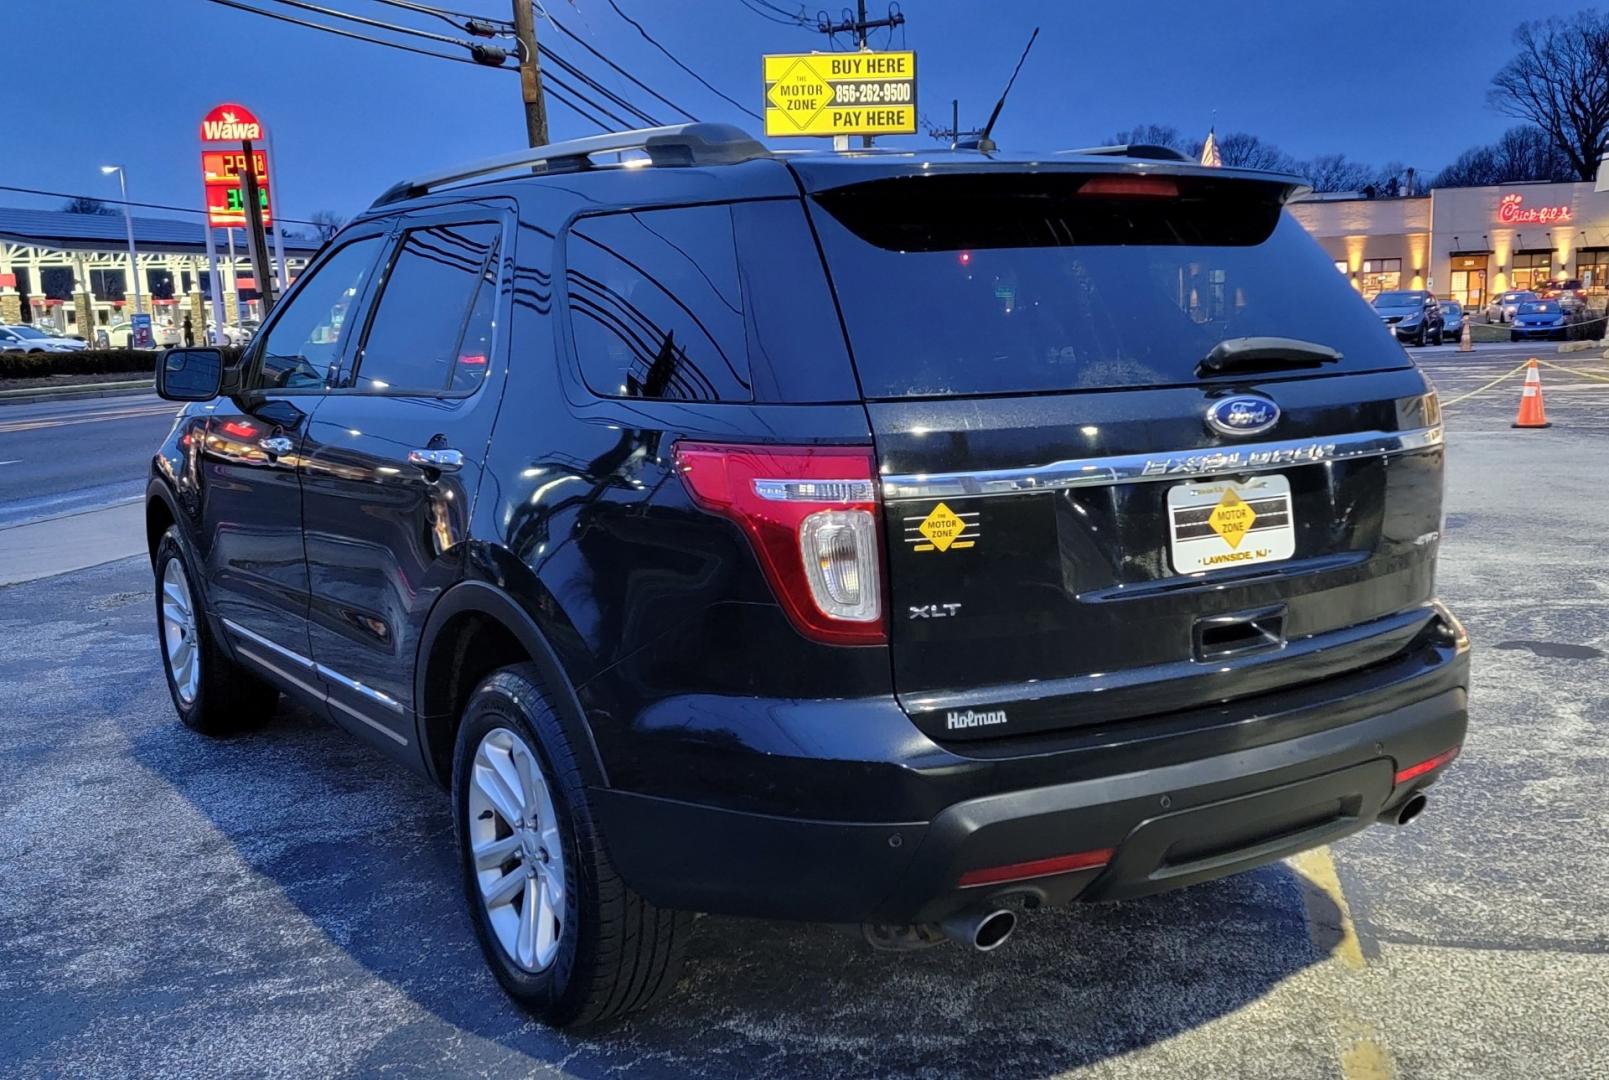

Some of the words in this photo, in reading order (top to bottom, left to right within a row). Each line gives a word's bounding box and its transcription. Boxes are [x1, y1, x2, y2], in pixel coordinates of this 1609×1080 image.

[832, 59, 862, 75] BUY
[866, 57, 906, 74] HERE
[780, 84, 823, 96] MOTOR
[787, 99, 817, 111] ZONE
[833, 111, 862, 127] PAY
[866, 110, 905, 126] HERE
[204, 121, 260, 140] Wawa
[1500, 201, 1572, 224] Chick-fil-A
[1228, 401, 1268, 426] Ford
[1217, 509, 1247, 521] MOTOR
[927, 520, 957, 529] MOTOR
[1222, 522, 1245, 534] ZONE
[932, 529, 953, 539] ZONE
[1255, 549, 1268, 558] NJ
[909, 603, 962, 619] XLT
[947, 710, 1007, 730] Holman
